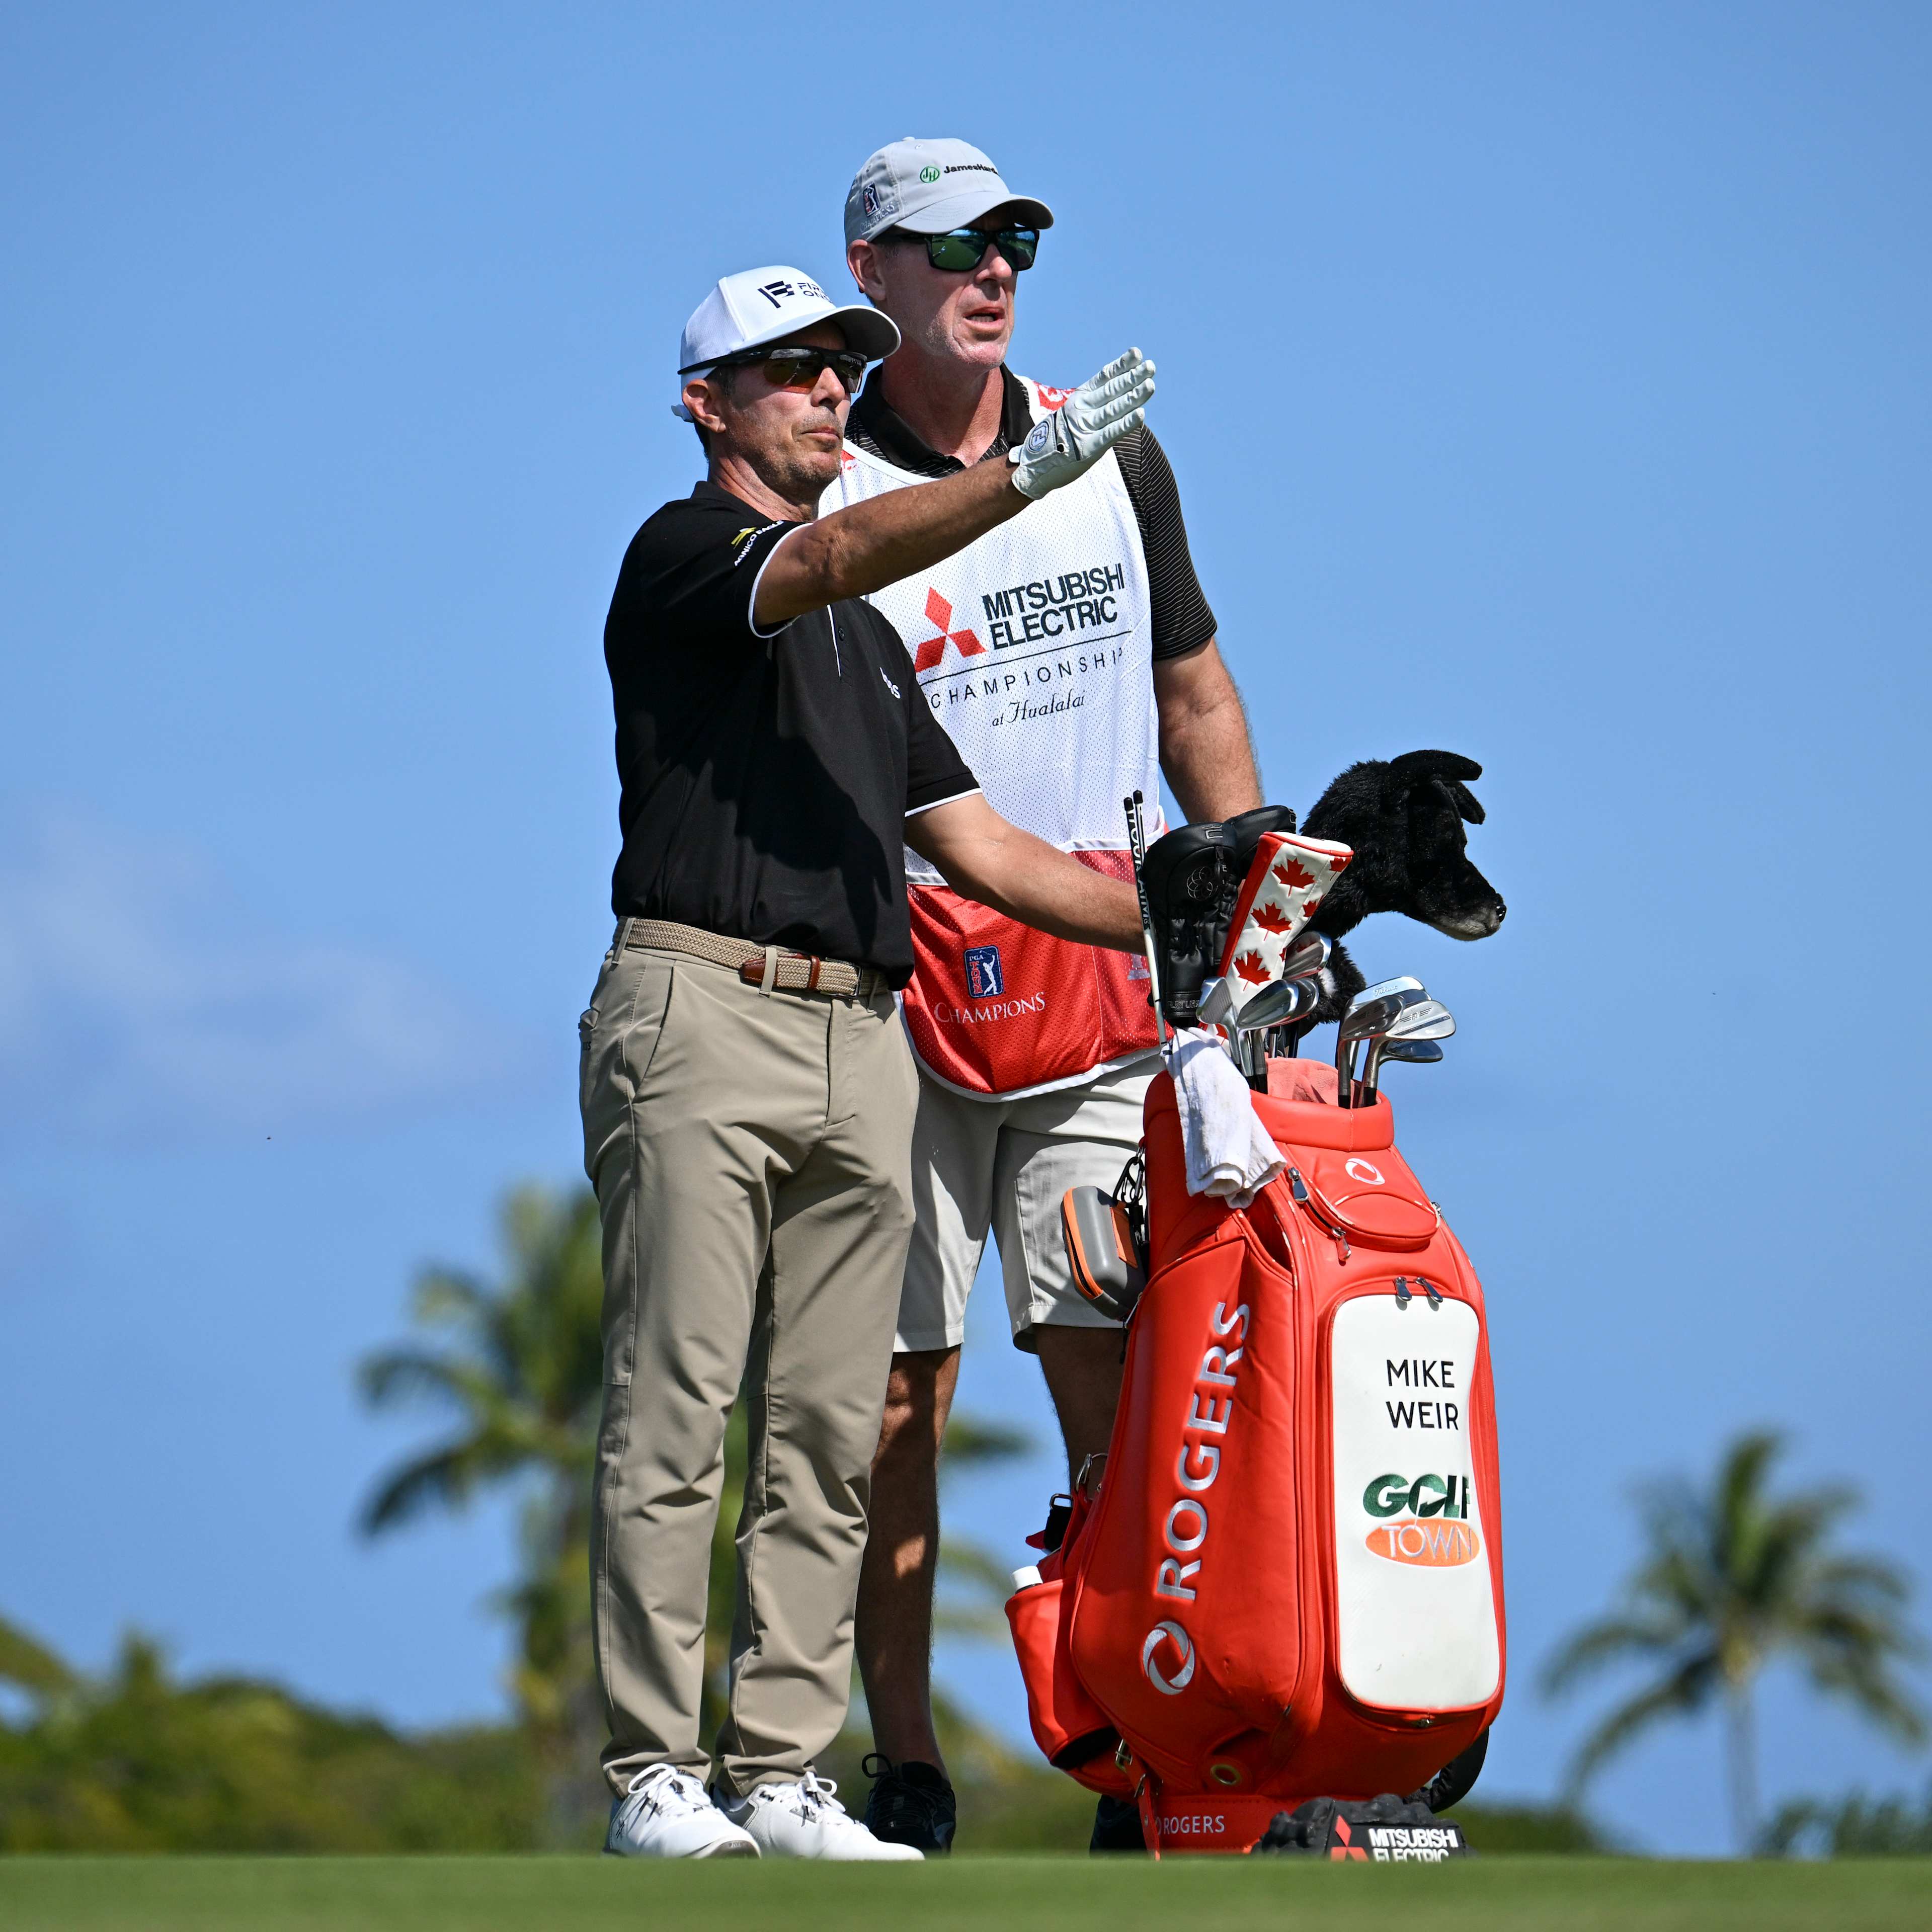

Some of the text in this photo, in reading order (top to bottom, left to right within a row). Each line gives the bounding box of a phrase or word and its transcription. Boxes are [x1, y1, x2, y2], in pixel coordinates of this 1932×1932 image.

[982, 562, 1124, 620] MITSUBISHI
[990, 596, 1118, 650] ELECTRIC
[992, 712, 1004, 727] at
[970, 960, 984, 994] TOUR
[934, 991, 1045, 1024] CHAMPIONS
[1386, 1359, 1455, 1389] MIKE
[1386, 1401, 1459, 1430] WEIR
[1157, 1302, 1250, 1601] ROGERS
[1363, 1473, 1471, 1519] GOLF
[1381, 1524, 1472, 1561] TOWN
[1163, 1815, 1225, 1835] ROGERS
[1368, 1828, 1459, 1848] MITSUBISHI
